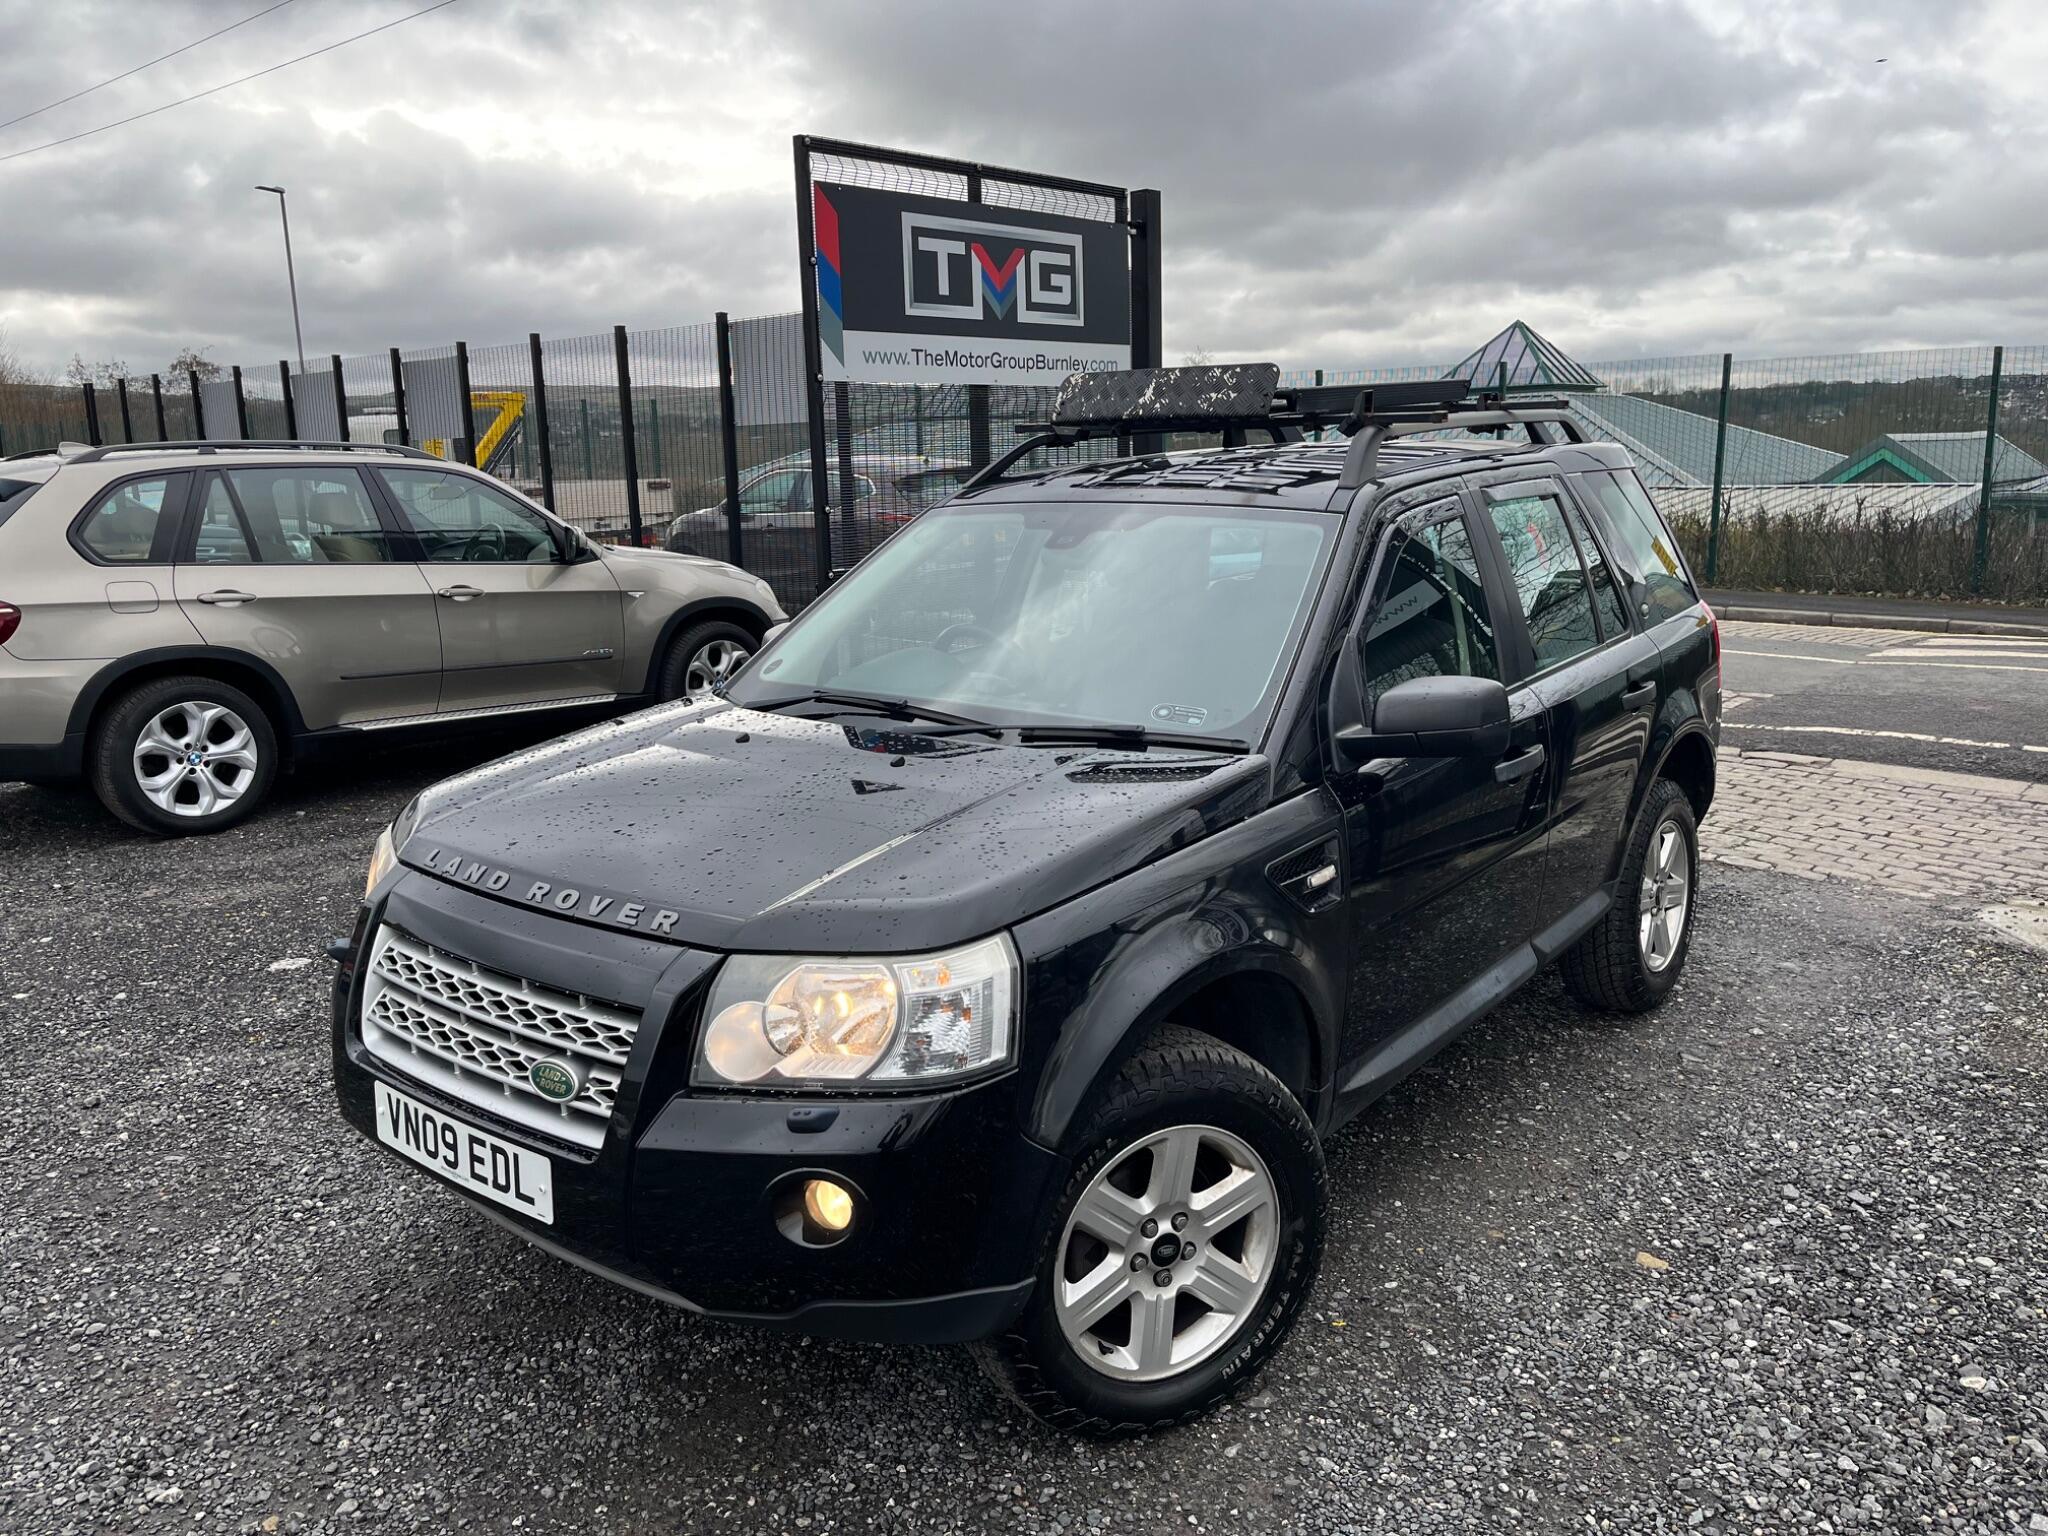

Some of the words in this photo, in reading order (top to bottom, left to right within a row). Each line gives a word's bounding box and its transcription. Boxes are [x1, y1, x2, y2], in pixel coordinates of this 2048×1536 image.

[918, 236, 1072, 322] TMG
[862, 348, 1118, 373] www.TheMotorGroupBurnley.com
[423, 848, 510, 891] LAND
[525, 881, 680, 935] ROVER
[539, 1066, 561, 1081] LAND
[540, 1078, 567, 1095] ROVER
[386, 1091, 460, 1170] VN09
[468, 1137, 535, 1206] EDL
[1221, 1291, 1290, 1380] TERRAIN
